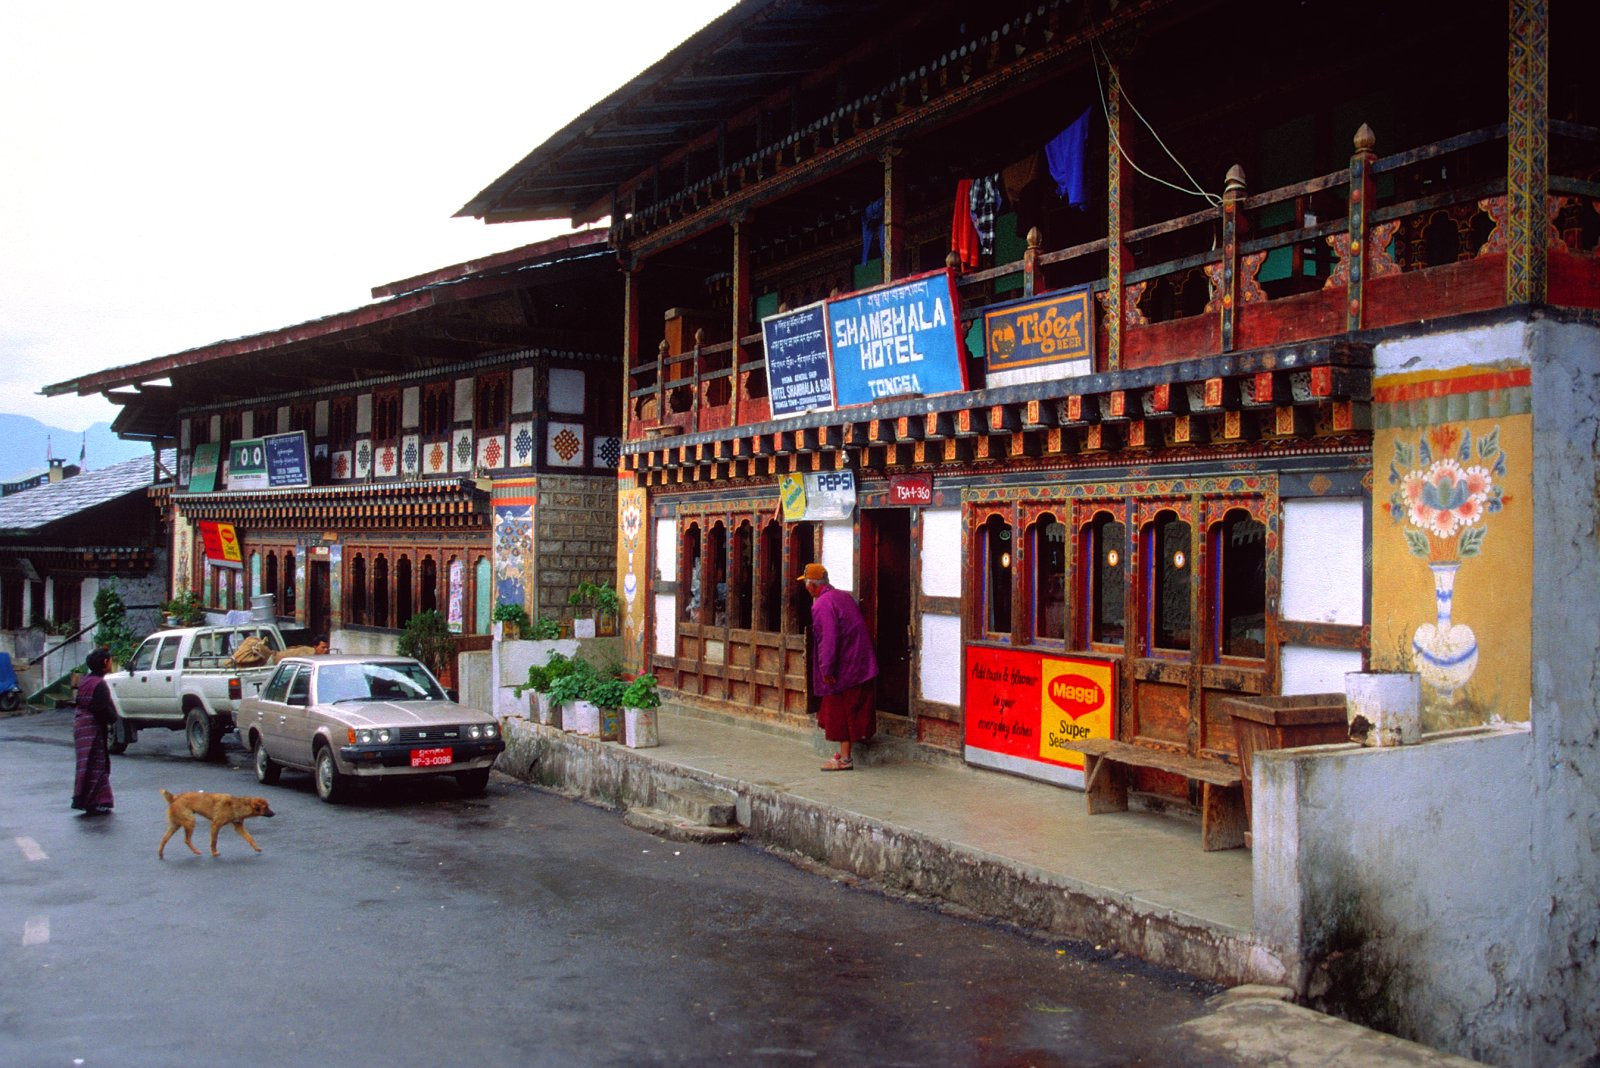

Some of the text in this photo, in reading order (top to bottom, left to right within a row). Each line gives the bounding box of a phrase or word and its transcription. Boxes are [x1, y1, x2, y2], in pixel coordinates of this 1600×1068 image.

[835, 297, 947, 348] SHAMBHALA
[1017, 307, 1082, 354] Tiger
[860, 333, 924, 371] HOTEL
[1057, 336, 1082, 350] BEER
[235, 446, 262, 466] POLO
[821, 473, 853, 492] PEPSI
[971, 661, 986, 681] Add
[1053, 681, 1099, 705] Maggi
[1059, 720, 1091, 739] Super
